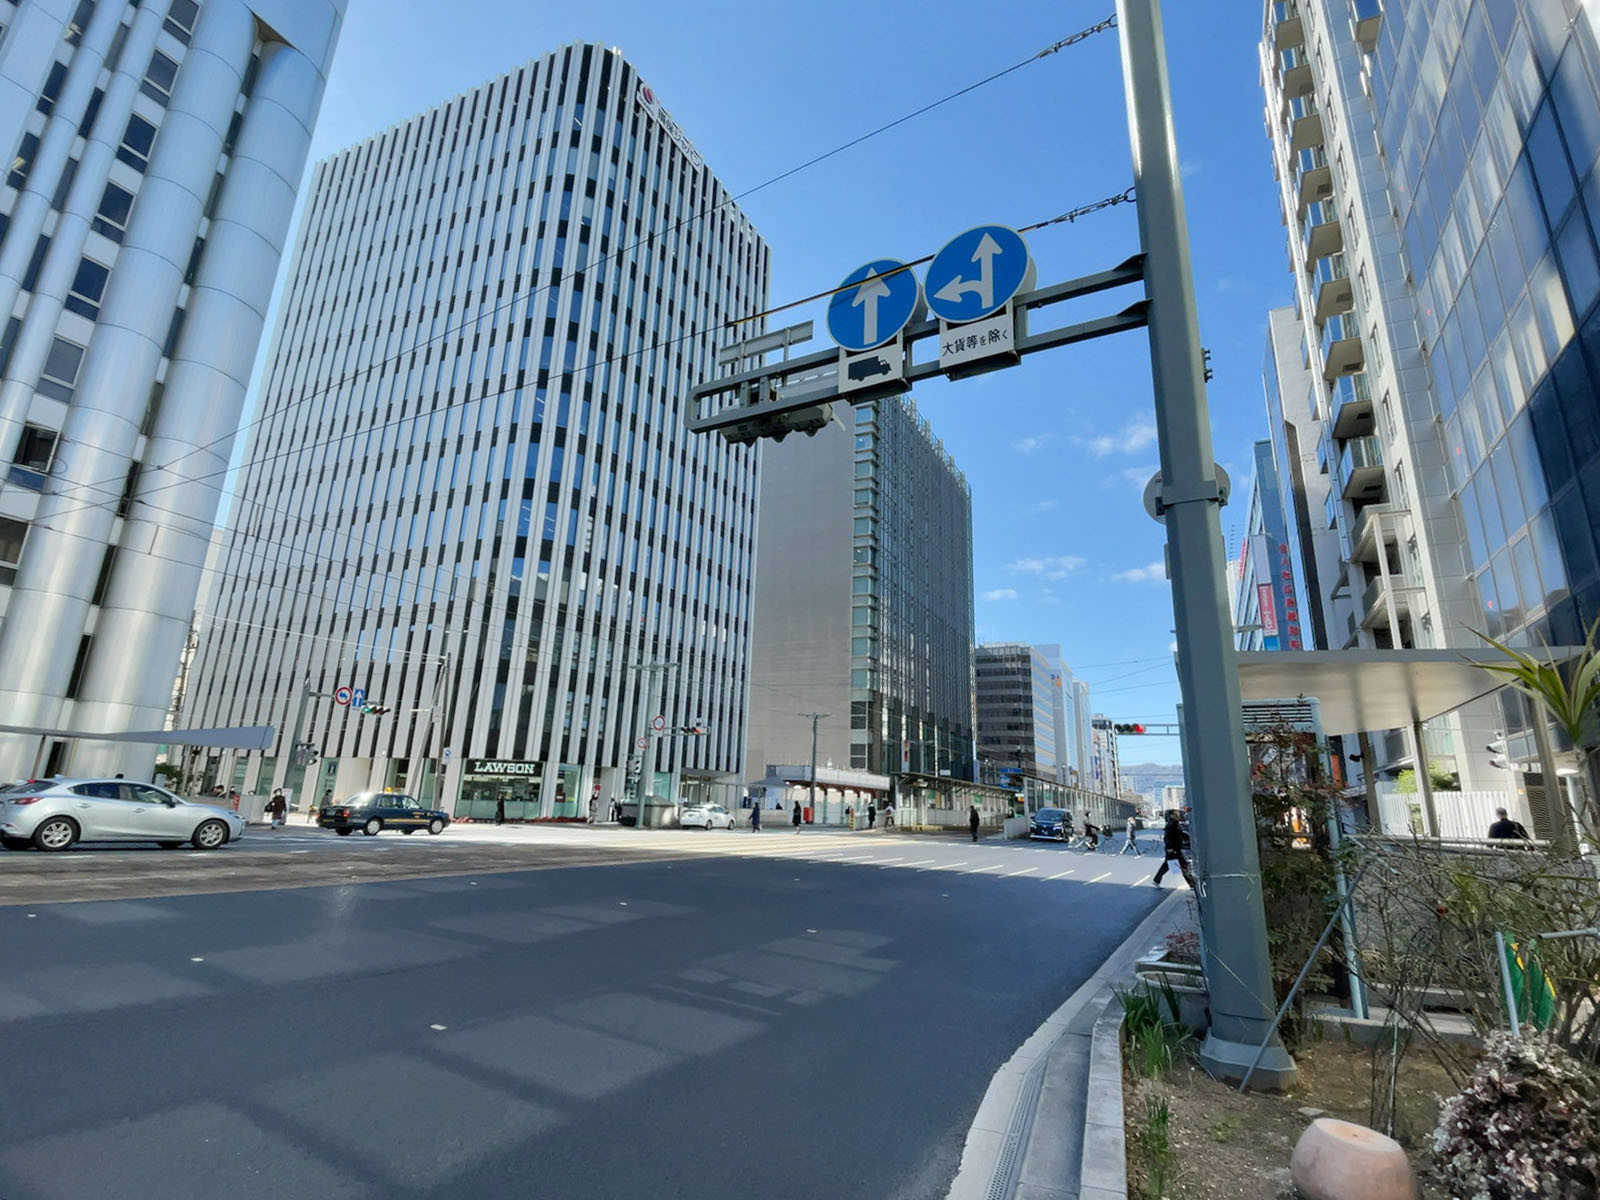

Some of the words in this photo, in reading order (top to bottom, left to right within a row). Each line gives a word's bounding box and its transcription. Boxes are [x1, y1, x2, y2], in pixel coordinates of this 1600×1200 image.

[942, 328, 1008, 357] 大貨等を除く
[474, 761, 535, 774] LAWSON
